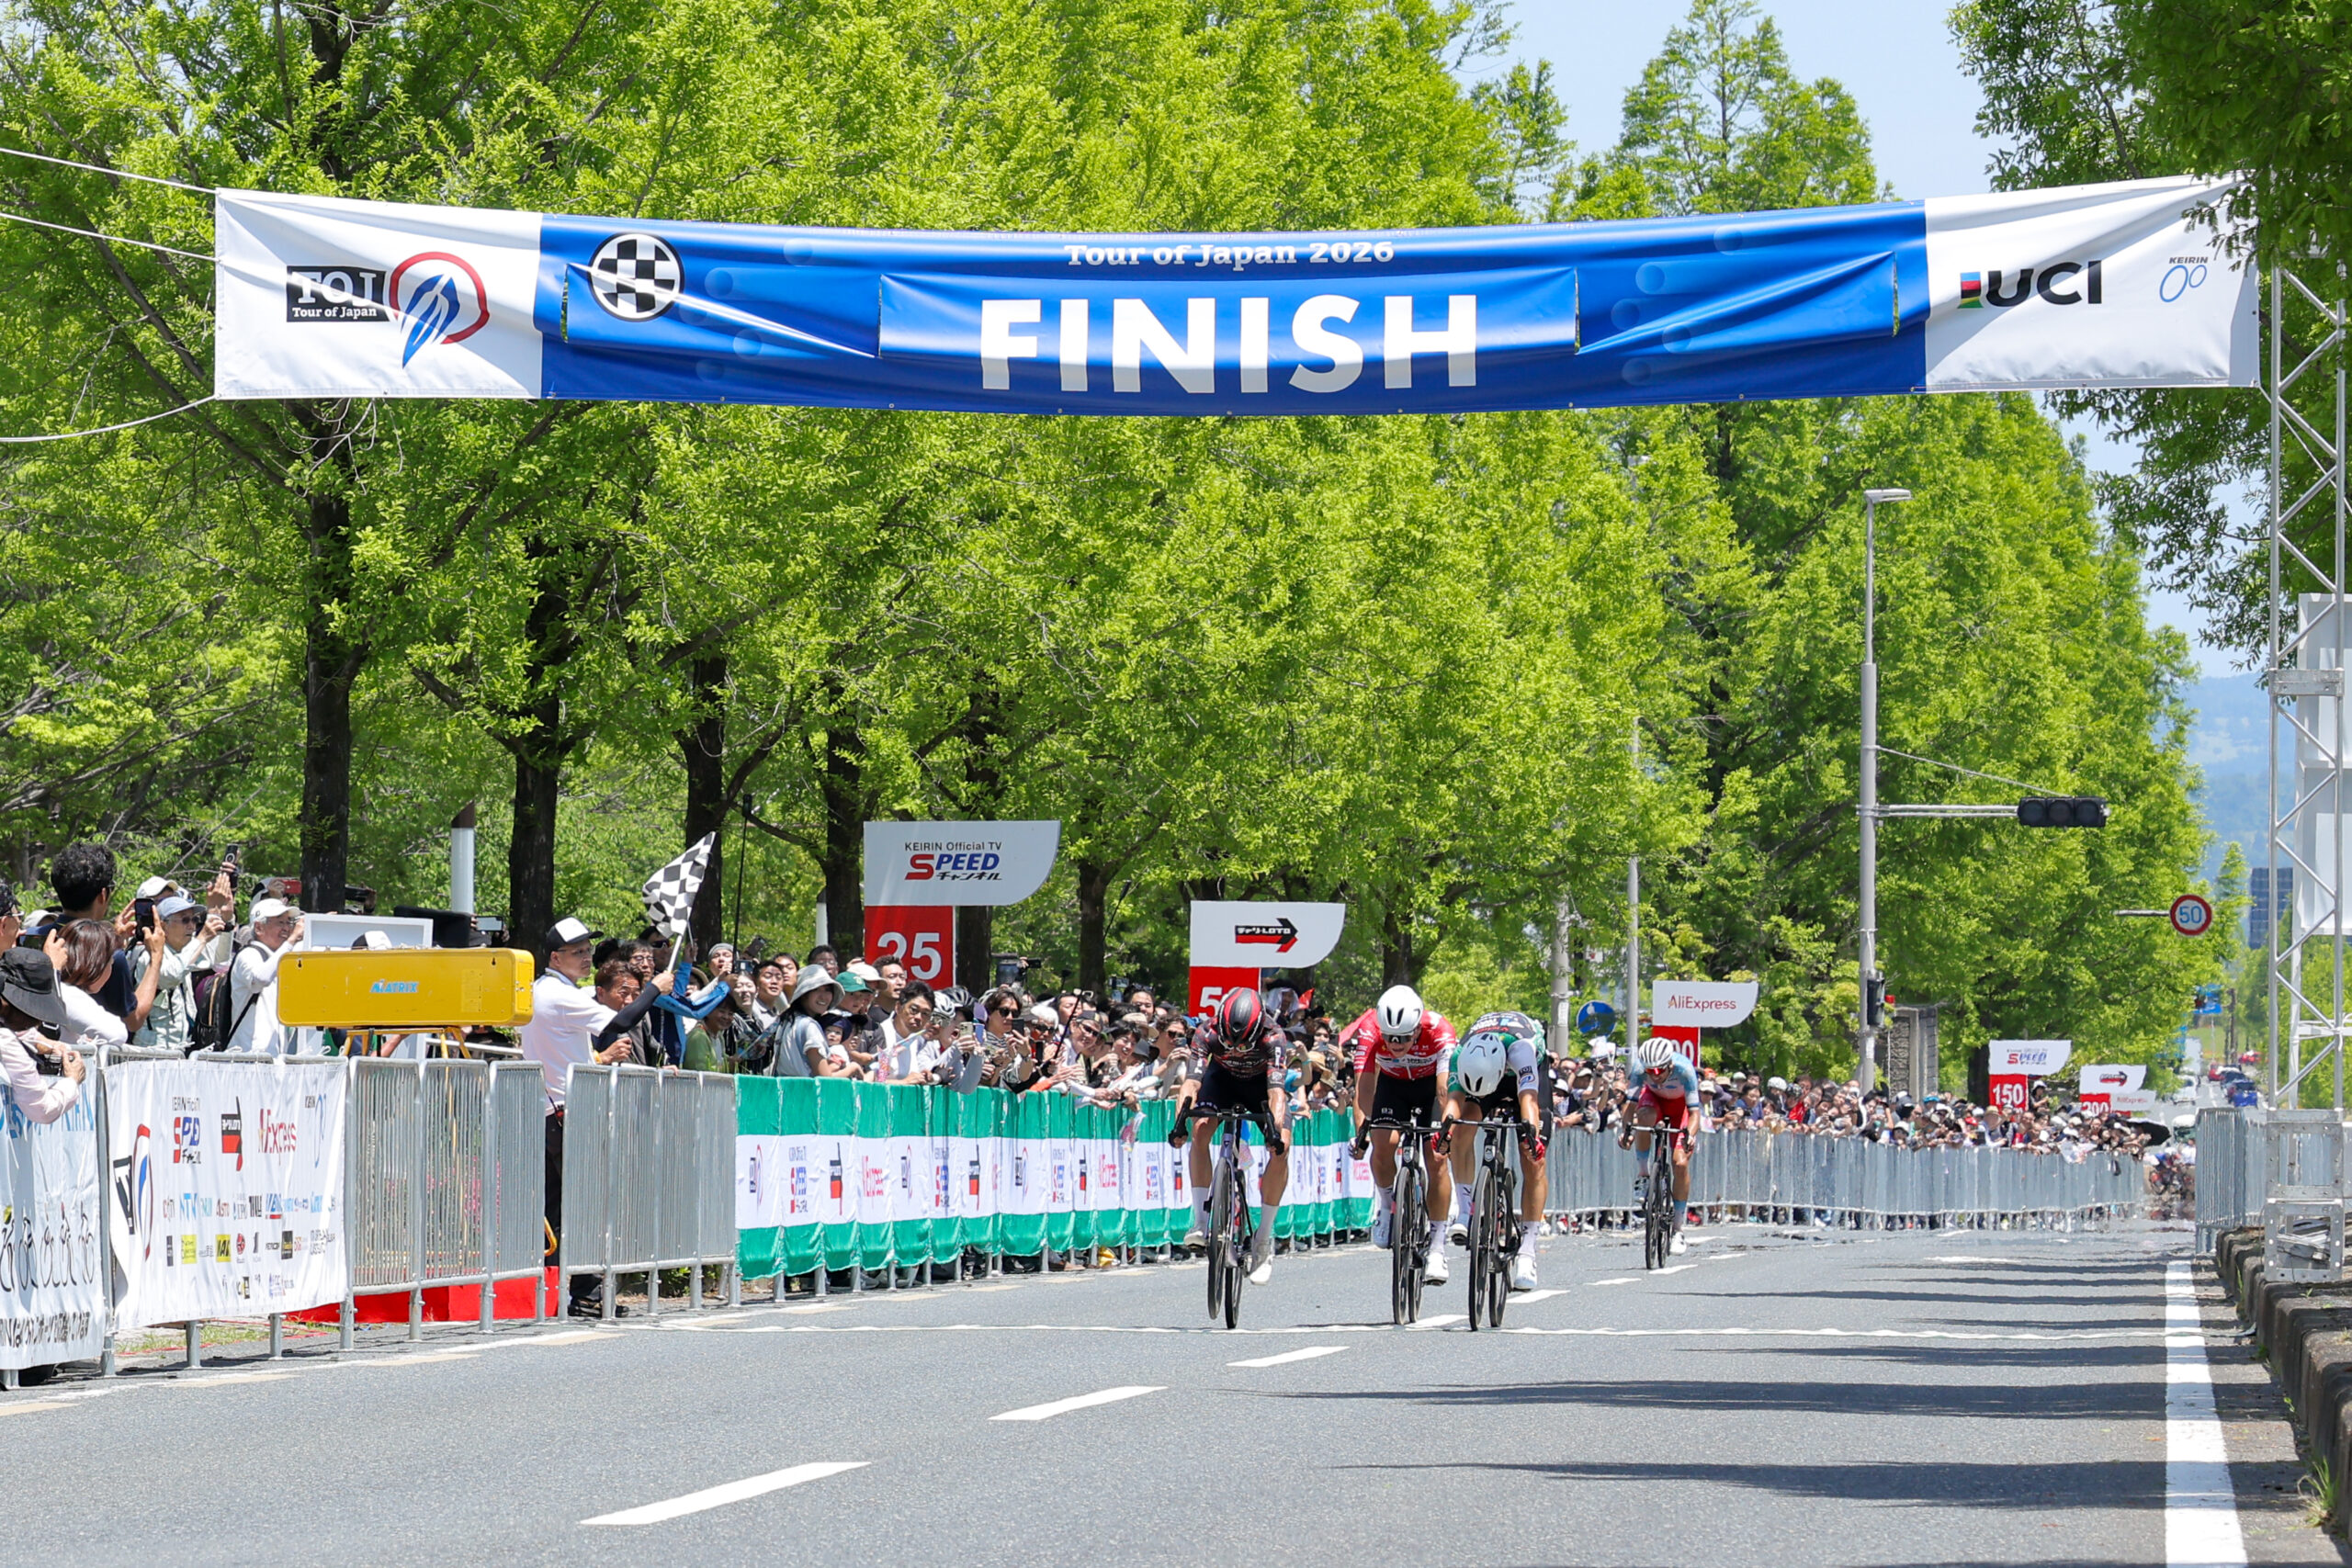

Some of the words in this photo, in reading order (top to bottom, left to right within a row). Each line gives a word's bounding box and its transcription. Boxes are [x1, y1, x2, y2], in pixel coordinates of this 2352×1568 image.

[1064, 244, 1146, 265] Tour
[1152, 243, 1191, 265] of
[1194, 243, 1297, 271] Japan
[1309, 241, 1395, 264] 2026
[2169, 256, 2209, 265] KEIRIN
[291, 271, 377, 307] TOJ
[1986, 260, 2102, 307] UCI
[292, 307, 322, 317] Tour
[324, 307, 338, 317] of
[339, 307, 377, 320] Japan
[980, 294, 1477, 394] FINISH
[905, 841, 943, 852] KEIRIN
[945, 841, 985, 852] Official
[988, 841, 1002, 851] TV
[904, 852, 1000, 881] SPEED
[936, 871, 1002, 881] チャンネル
[2178, 905, 2203, 924] 50
[876, 931, 942, 980] 25
[1668, 994, 1736, 1011] AliExpress
[1992, 1083, 2024, 1105] 150
